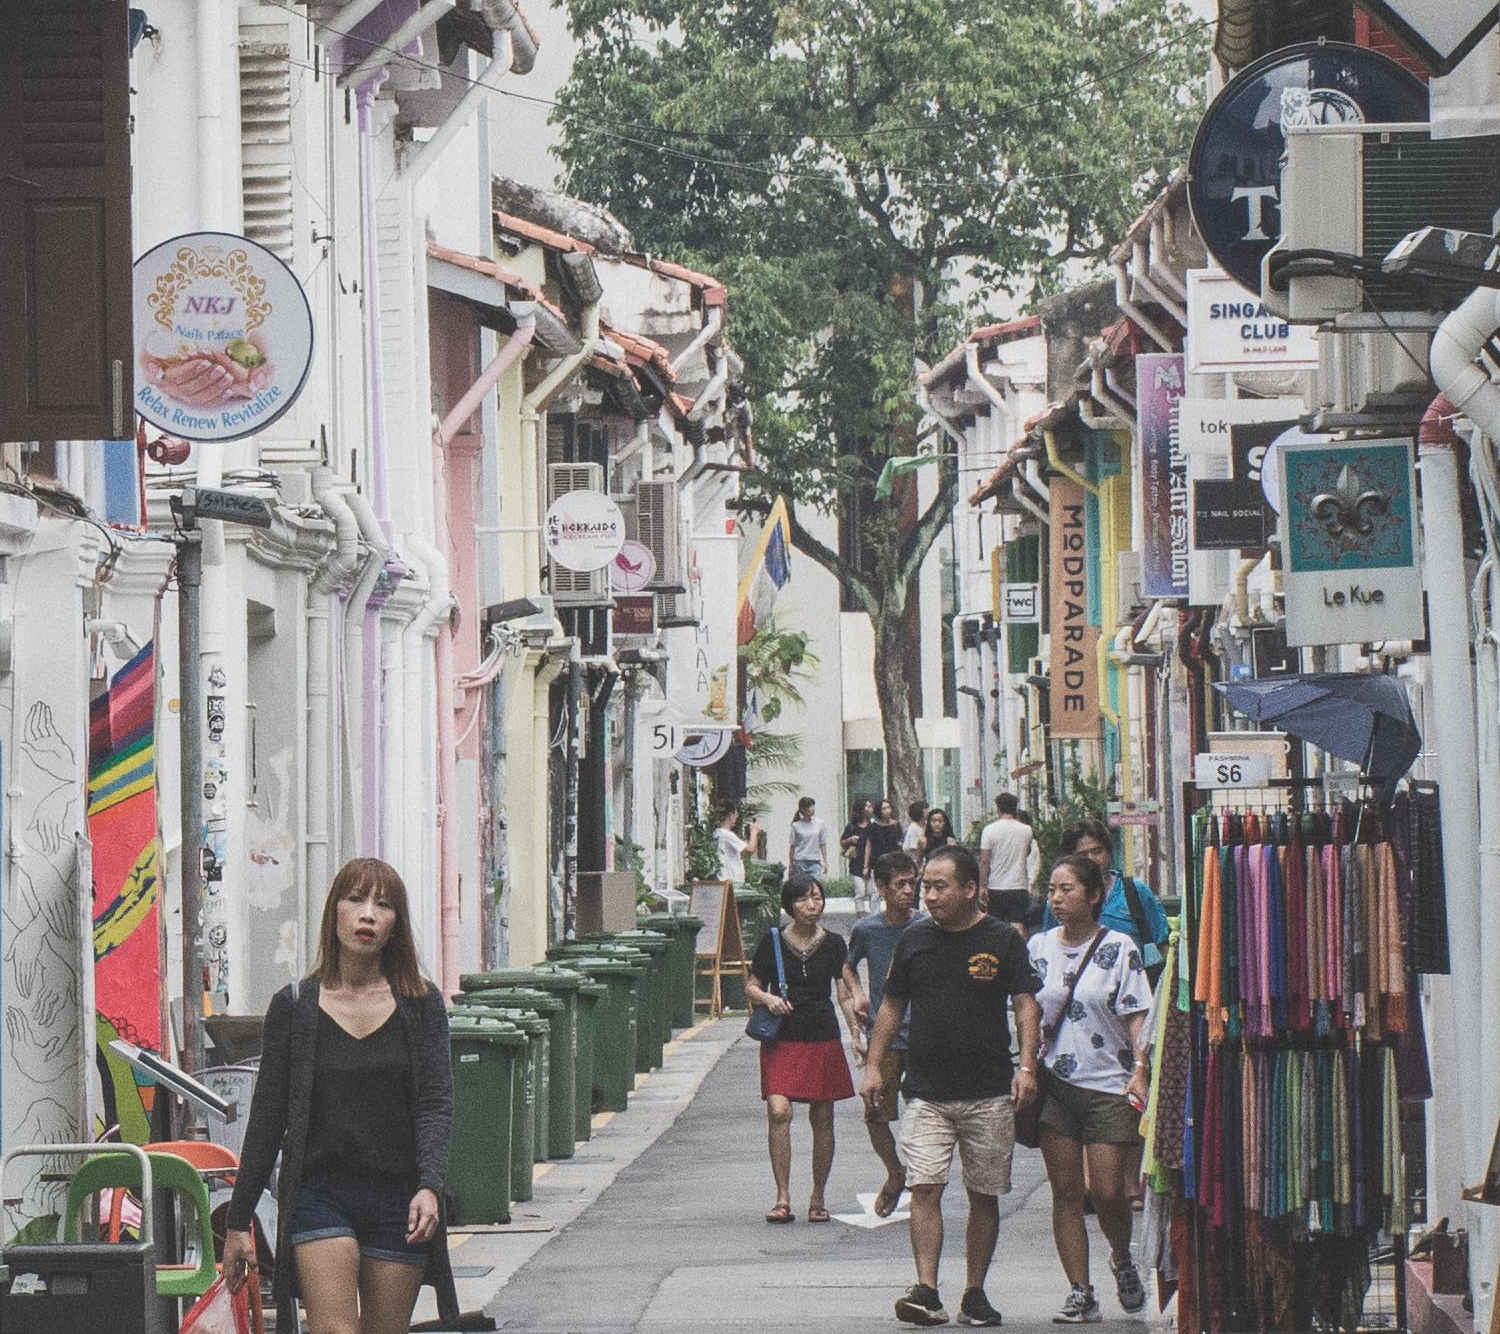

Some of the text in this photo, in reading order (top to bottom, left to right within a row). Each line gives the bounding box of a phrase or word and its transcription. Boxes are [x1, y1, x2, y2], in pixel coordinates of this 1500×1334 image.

[183, 295, 237, 315] NKJ
[1210, 302, 1273, 319] SINGA
[175, 325, 244, 341] Nails Palace
[1240, 323, 1290, 340] CLUB
[137, 385, 282, 430] Relax Renew Revitalize
[561, 523, 617, 532] HOKKAIDO
[1322, 585, 1385, 608] Le Kue
[652, 724, 675, 750] 51
